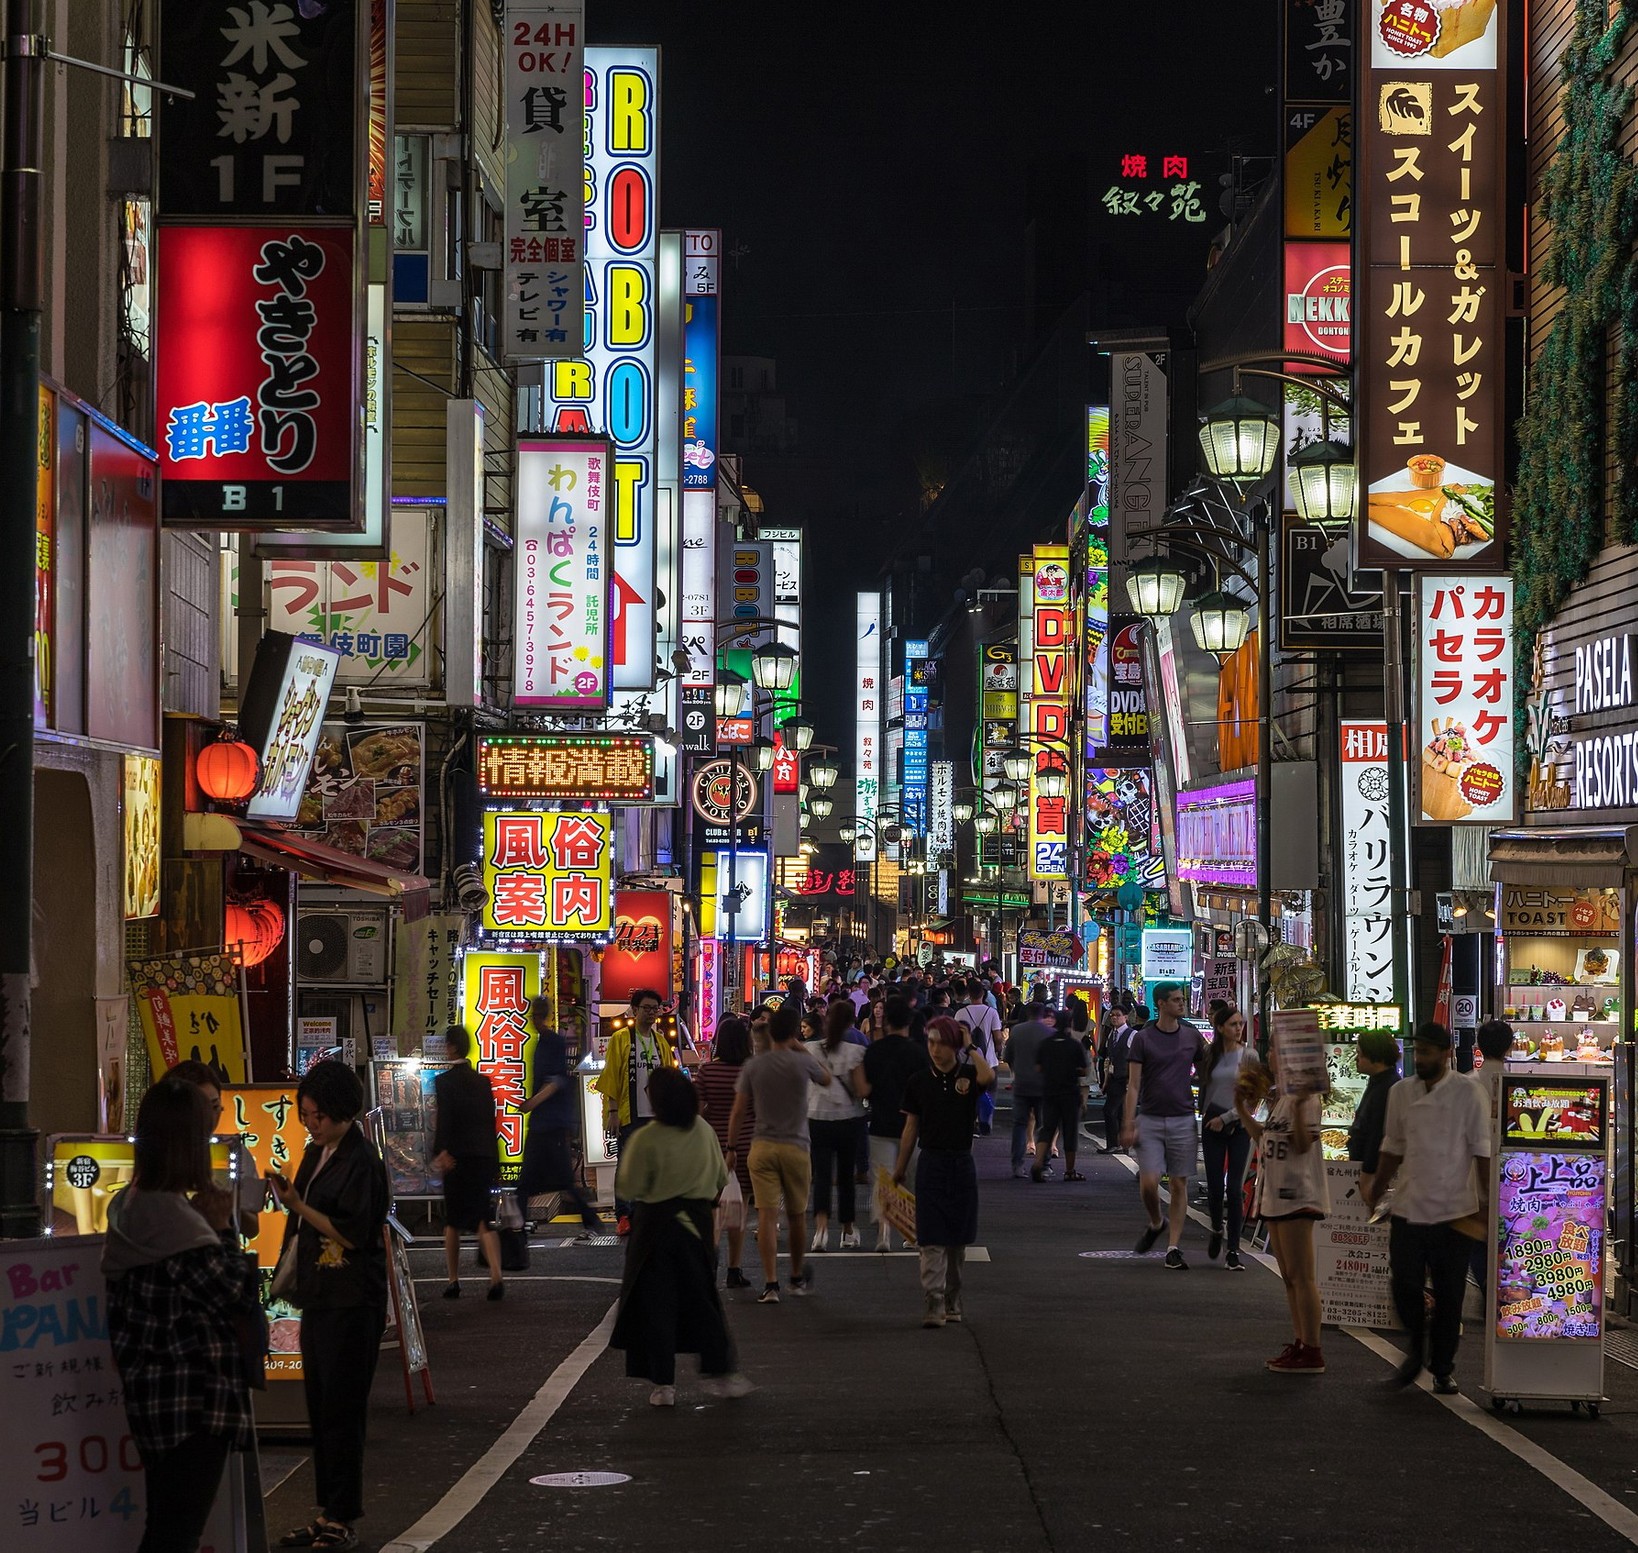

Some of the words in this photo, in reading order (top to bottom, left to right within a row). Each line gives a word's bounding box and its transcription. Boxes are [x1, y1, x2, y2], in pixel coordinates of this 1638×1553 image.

[1401, 3, 1429, 23] 名物
[514, 22, 575, 47] 24H
[1384, 14, 1431, 42] ハニトー
[1386, 27, 1405, 38] HONEY
[1406, 34, 1422, 45] TOAST
[1387, 34, 1403, 44] SINCE
[1404, 41, 1417, 49] 1993
[216, 0, 308, 143] 米新
[519, 52, 571, 73] OK!
[1290, 114, 1314, 128] 4F
[520, 87, 567, 232] 貸室
[1122, 155, 1187, 179] 焼肉
[211, 155, 304, 202] 1F
[1101, 181, 1207, 223] 叙々苑
[510, 237, 576, 264] 完全個室
[1447, 83, 1486, 445] スイーツ&ガレット
[697, 283, 715, 293] 5F
[1385, 147, 1425, 445] スコールカフェ
[516, 271, 539, 342] テレビ有
[545, 271, 568, 342] シャワー有
[604, 66, 653, 546] ROBOT
[254, 235, 325, 474] やきとり
[1155, 354, 1166, 365] 2F
[587, 457, 601, 511] 歌舞伎町
[764, 530, 796, 538] フジビル
[1296, 537, 1317, 550] B1
[587, 527, 599, 580] 24時間
[546, 464, 578, 685] わんぱくランド
[585, 595, 598, 635] 託児所
[691, 606, 709, 616] 3F
[525, 554, 535, 690] 03-6457-3978
[1428, 585, 1466, 705] パセラ
[692, 671, 709, 680] 2F
[1472, 586, 1508, 746] カラオケ
[1575, 633, 1632, 713] PASELA
[576, 678, 596, 690] 2F
[862, 677, 874, 711] 焼肉
[689, 715, 702, 726] 2F
[717, 723, 749, 739] たばこ
[863, 737, 873, 769] 叙々苑
[487, 748, 645, 785] 情報満載
[1576, 730, 1638, 809] RESORTS
[1464, 775, 1500, 788] ハニトー
[1469, 787, 1490, 796] HONEY
[1469, 793, 1488, 802] TOAST
[702, 800, 747, 819] TOKO
[748, 826, 758, 836] B1
[493, 816, 604, 870] 風俗
[1037, 843, 1064, 864] 24
[492, 871, 602, 925] 案内
[1506, 890, 1576, 908] ハニトー
[1507, 912, 1566, 925] TOAST
[1021, 949, 1045, 963] 受付
[1458, 1002, 1471, 1013] 20
[477, 966, 530, 1156] 風俗案内
[1267, 1139, 1287, 1160] 36
[73, 1173, 94, 1187] 3F
[1519, 1156, 1598, 1194] 上上品
[1510, 1198, 1541, 1212] 焼肉
[1563, 1221, 1590, 1239] 食べ
[1506, 1239, 1553, 1260] 1890円
[1559, 1236, 1588, 1253] 放題
[1525, 1251, 1572, 1272] 2980円
[6, 1263, 80, 1300] Bar
[1537, 1266, 1583, 1287] 3980円
[1548, 1280, 1594, 1300] 4980円
[1500, 1297, 1542, 1317] 飲み放題
[1565, 1303, 1592, 1316] 1500円
[1507, 1323, 1529, 1334] 500円
[1537, 1313, 1559, 1325] 800円
[1563, 1323, 1598, 1337] 焼き鳥
[12, 1358, 104, 1379] ご新規様
